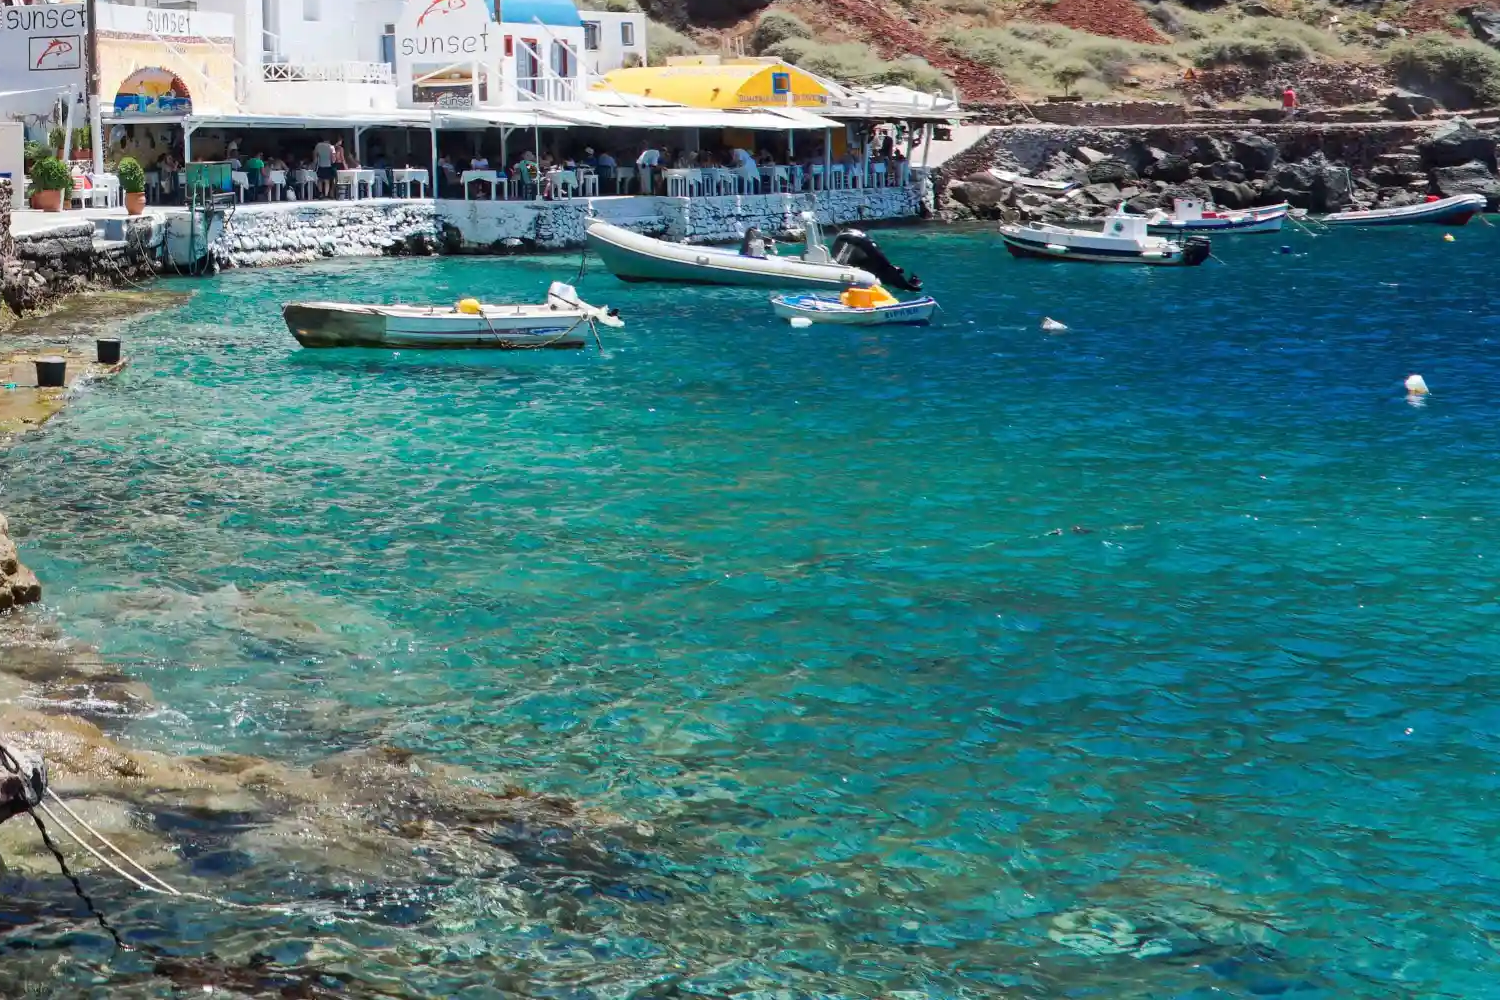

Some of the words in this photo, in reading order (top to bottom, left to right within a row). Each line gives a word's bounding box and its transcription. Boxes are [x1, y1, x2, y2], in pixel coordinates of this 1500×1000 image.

[6, 4, 86, 31] sunset
[147, 10, 191, 34] sunset
[402, 23, 488, 56] sunset
